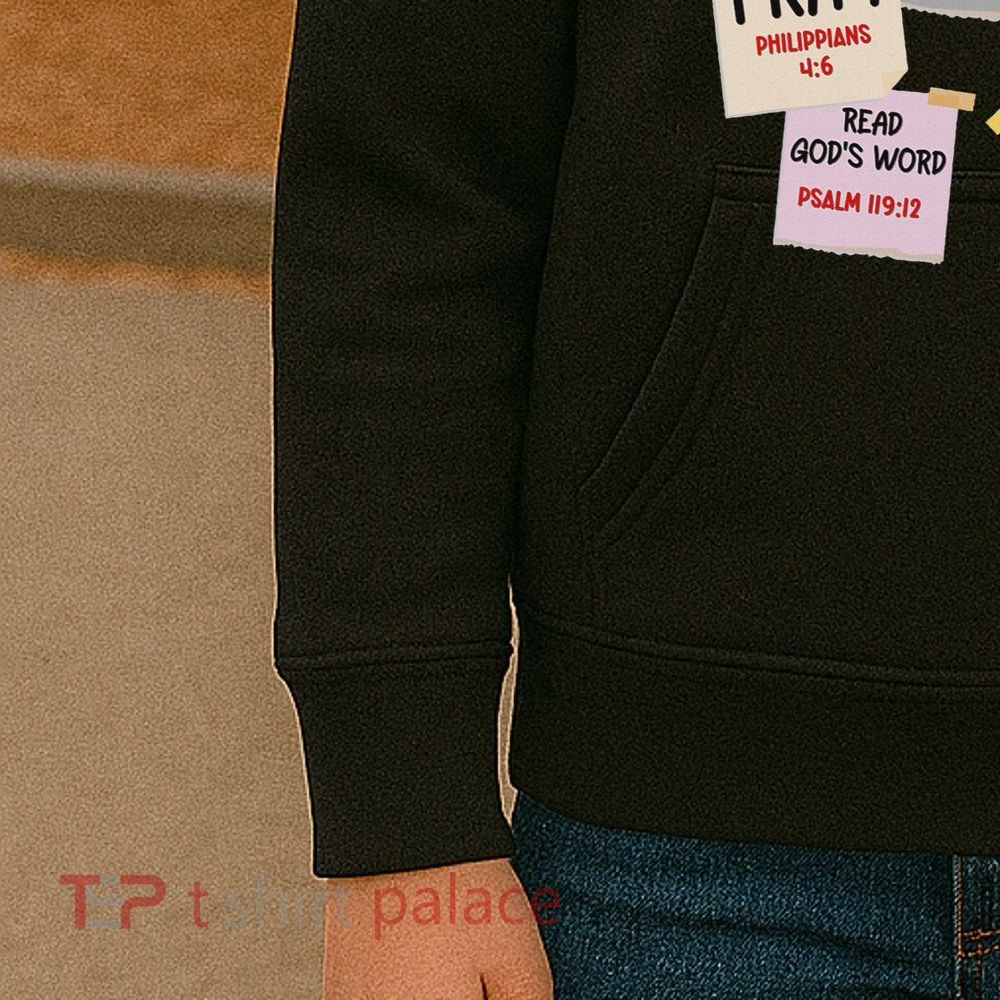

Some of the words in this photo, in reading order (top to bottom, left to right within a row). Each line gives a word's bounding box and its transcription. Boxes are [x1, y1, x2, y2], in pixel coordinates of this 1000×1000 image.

[755, 24, 872, 56] PHILIPPIANS
[800, 56, 834, 79] 4:6
[842, 107, 903, 136] READ
[790, 137, 864, 169] GOD'S
[873, 144, 947, 176] WORD
[797, 186, 861, 214] PSALM
[867, 193, 922, 219] 119:12
